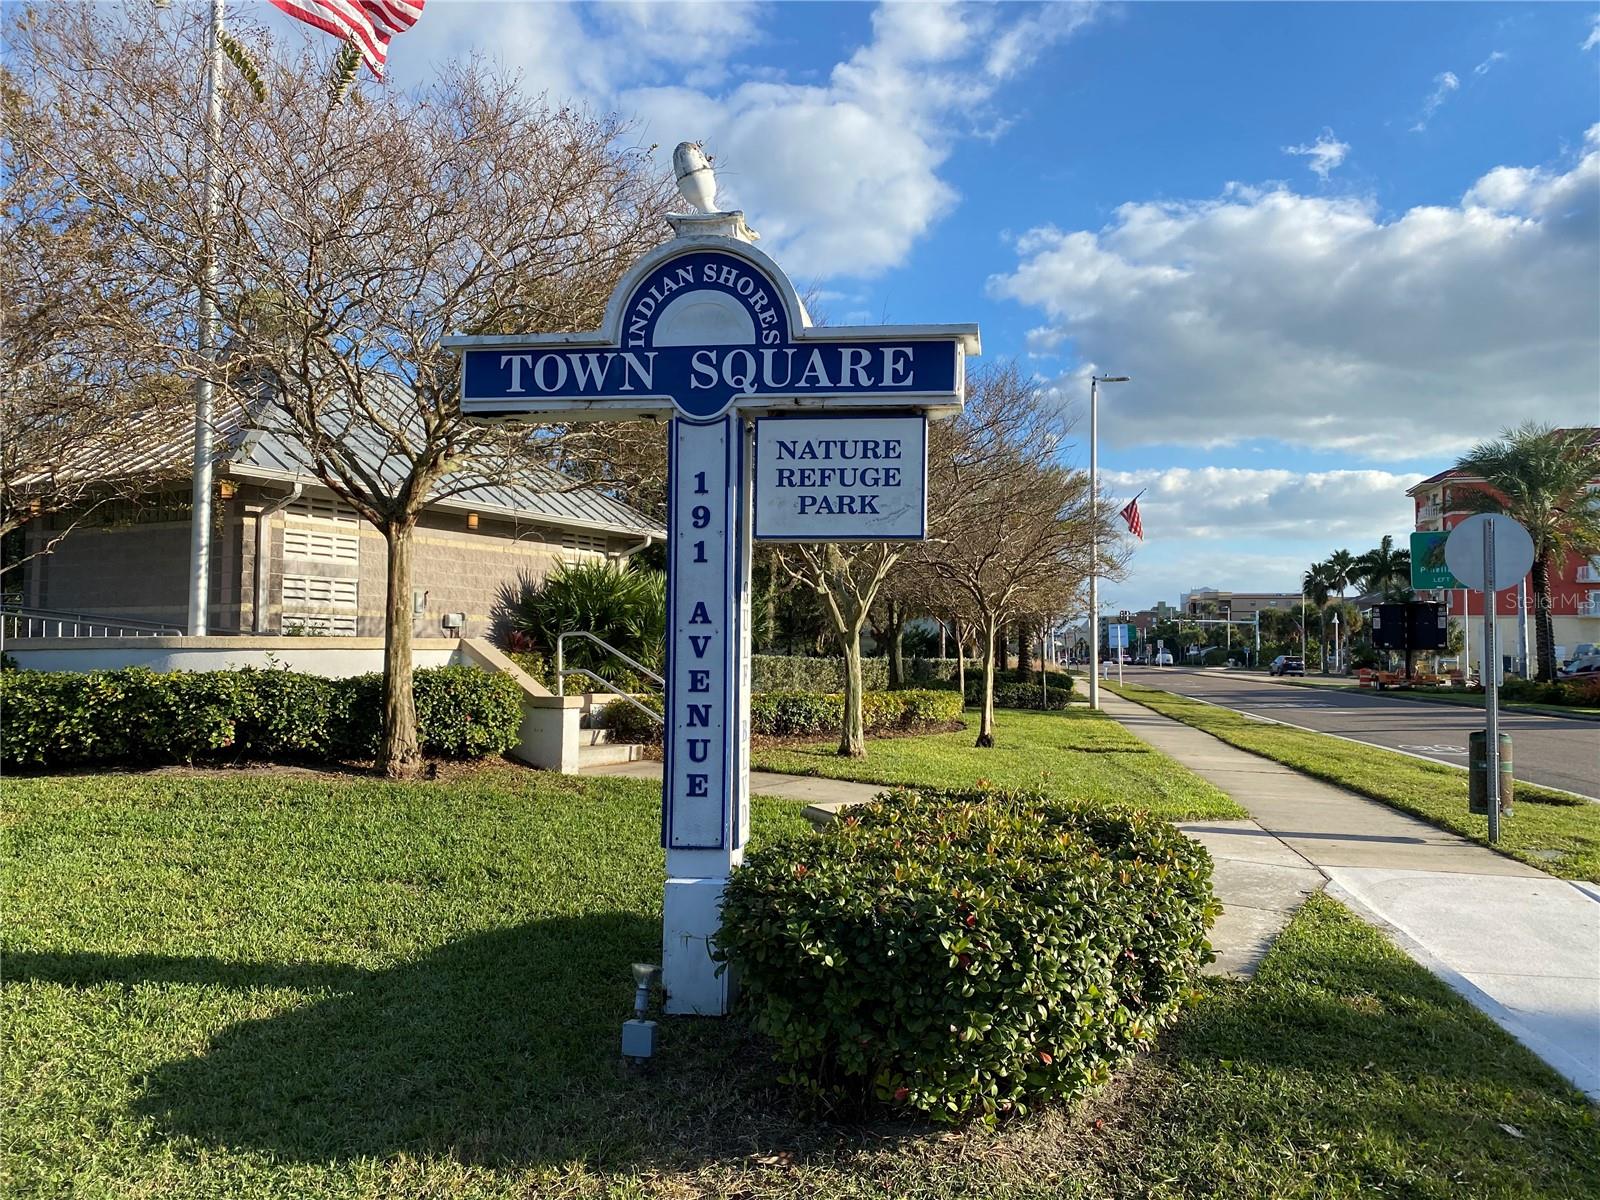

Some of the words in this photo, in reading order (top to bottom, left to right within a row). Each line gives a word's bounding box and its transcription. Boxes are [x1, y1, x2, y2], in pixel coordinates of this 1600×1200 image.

[628, 266, 694, 348] INDIAN
[703, 264, 781, 345] SHORES
[500, 352, 658, 393] TOWN
[690, 347, 914, 394] SQUARE
[775, 439, 902, 460] NATURE
[775, 467, 902, 488] REFUGE
[691, 471, 711, 563] 191
[797, 495, 880, 516] PARK
[686, 601, 712, 798] AVENUE
